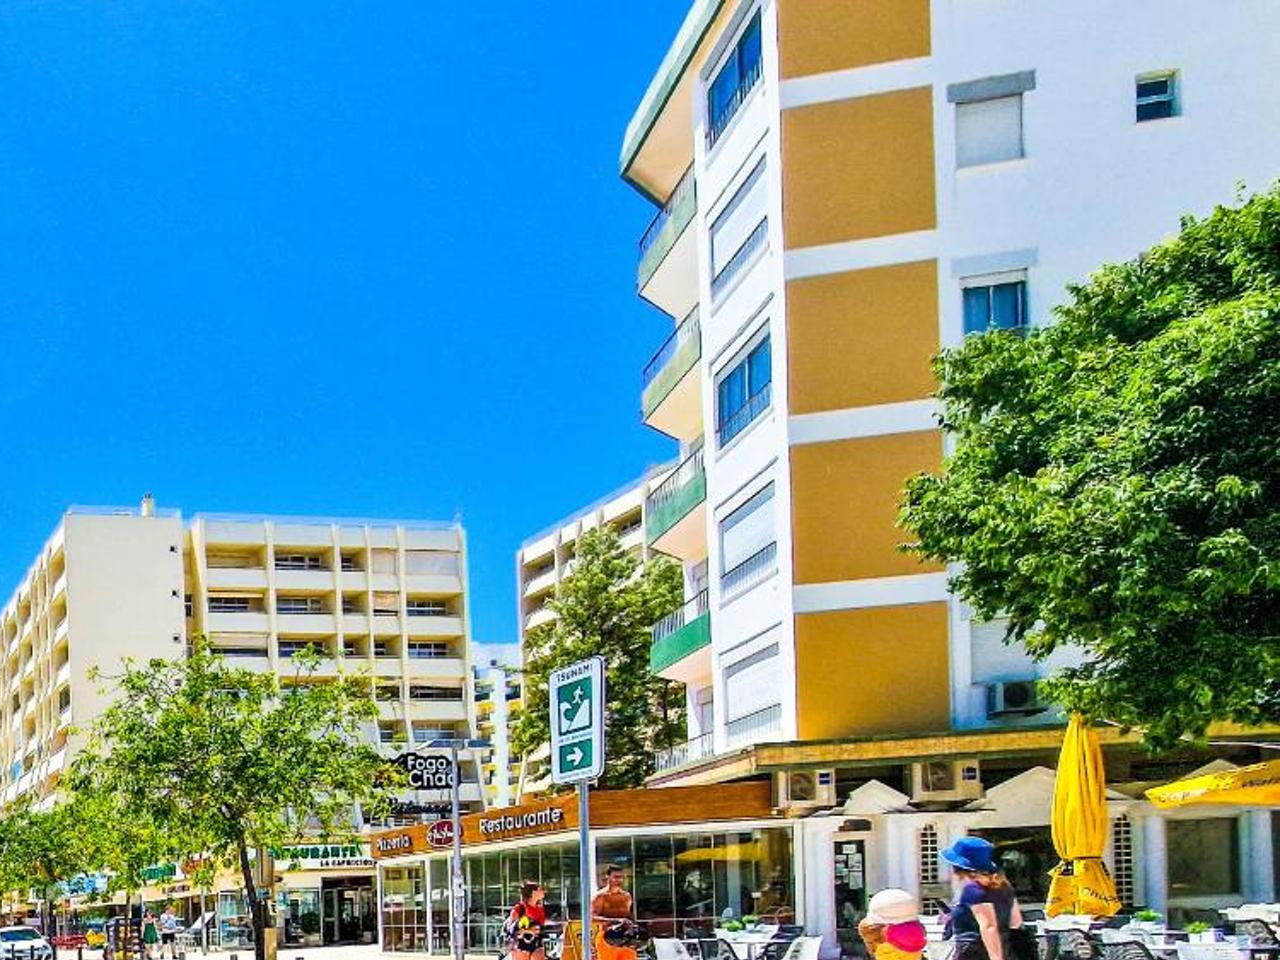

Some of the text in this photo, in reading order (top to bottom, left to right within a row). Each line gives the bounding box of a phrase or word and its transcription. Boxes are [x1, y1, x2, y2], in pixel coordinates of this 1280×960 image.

[556, 664, 593, 681] TSUNAMI
[407, 756, 447, 774] Fogo
[478, 807, 562, 834] Restaurante
